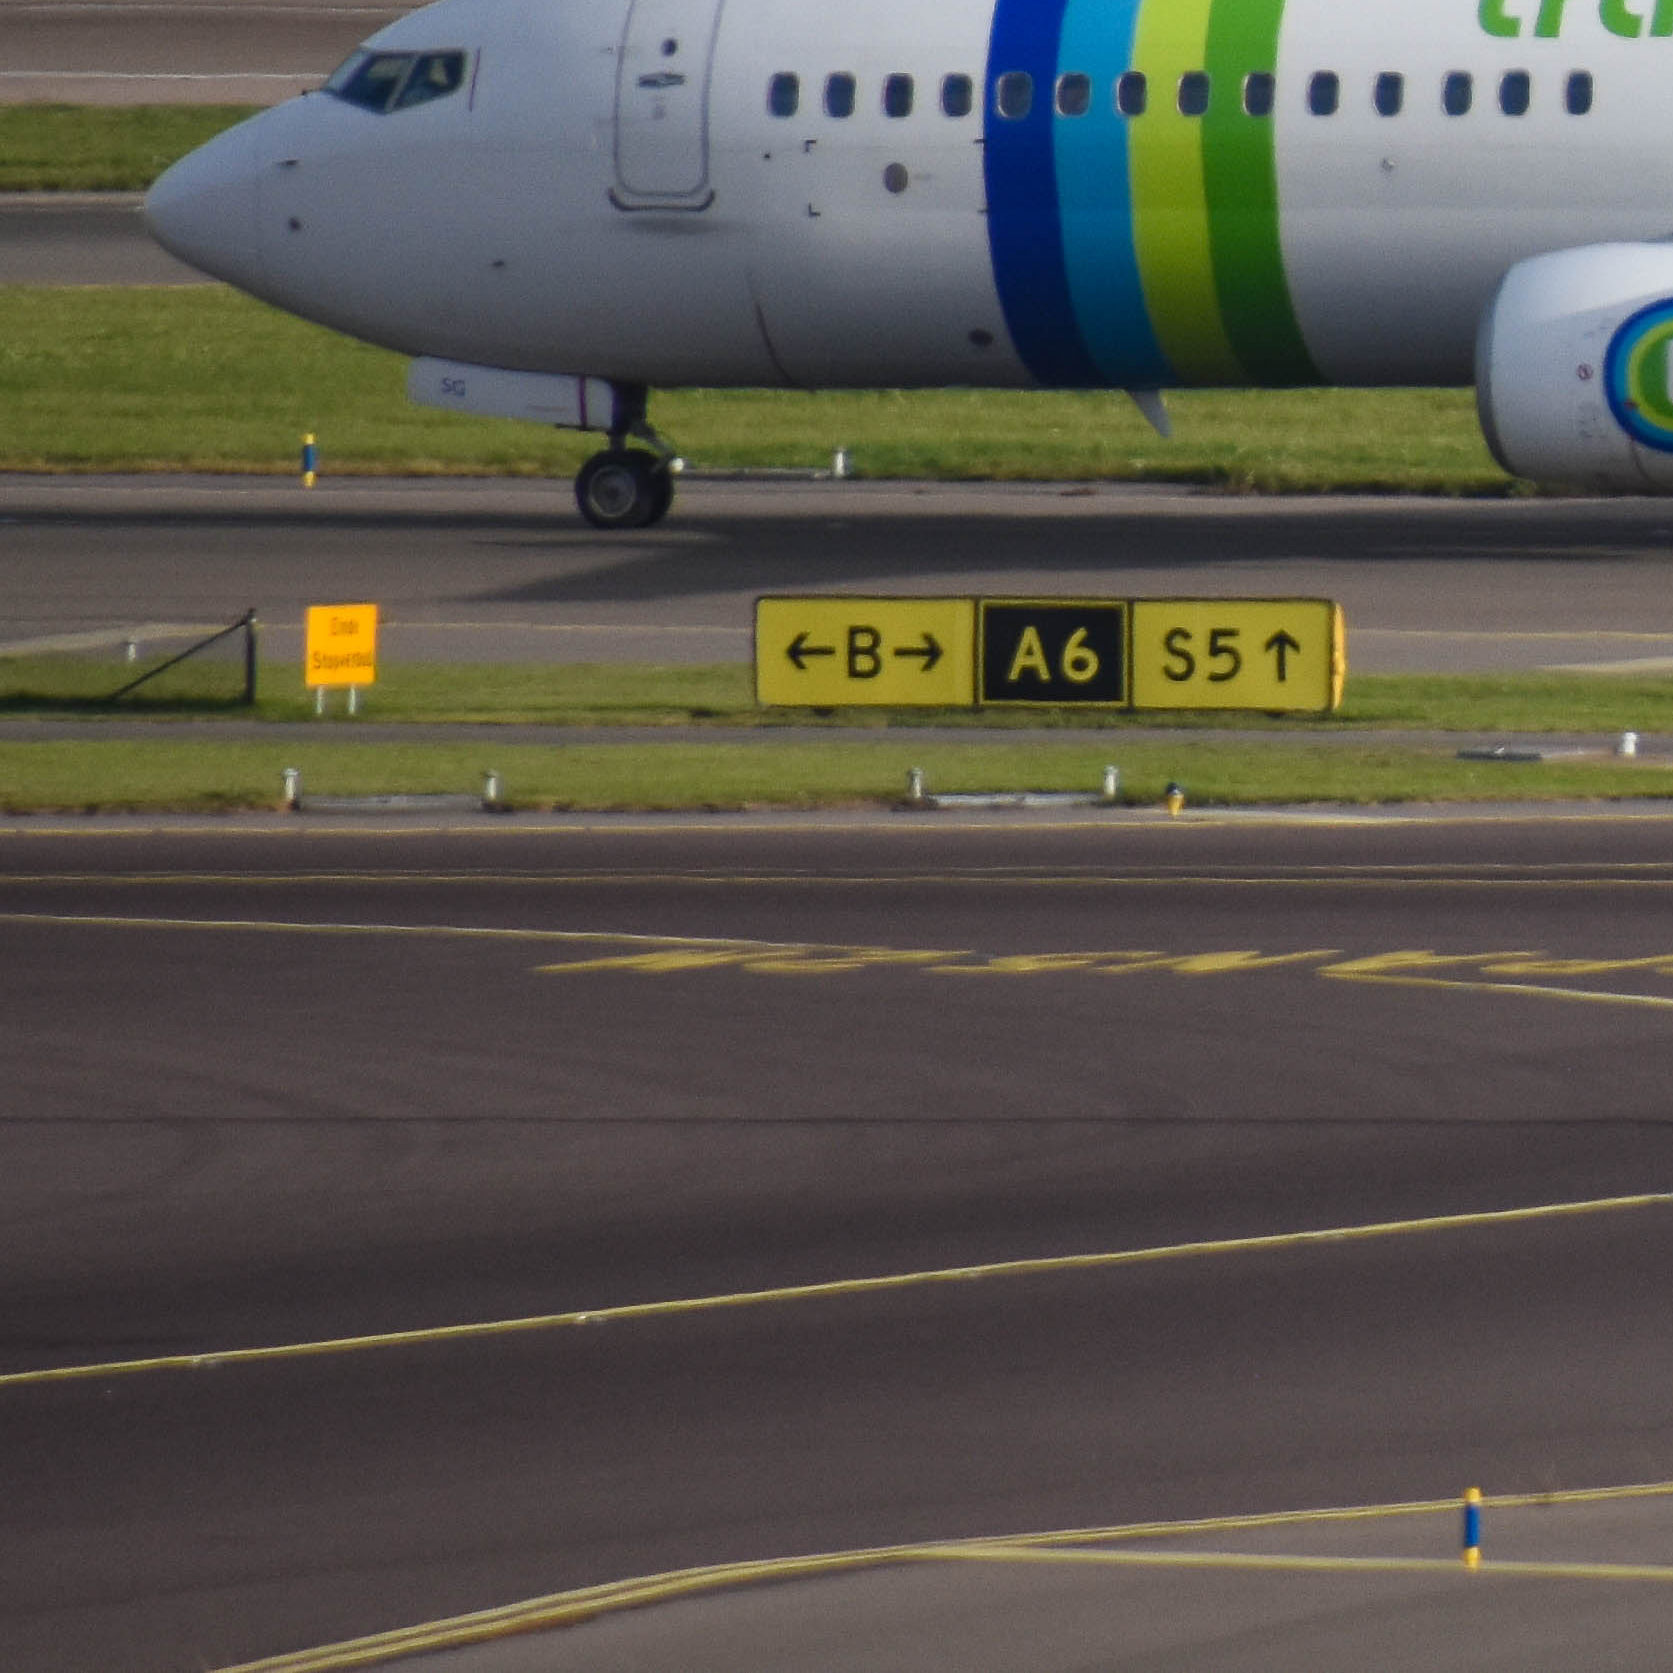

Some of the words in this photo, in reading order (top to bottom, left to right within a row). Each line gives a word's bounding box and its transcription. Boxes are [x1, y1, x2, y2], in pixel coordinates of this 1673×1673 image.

[846, 626, 883, 679] B
[1008, 626, 1099, 682] A6
[1162, 627, 1242, 682] S5
